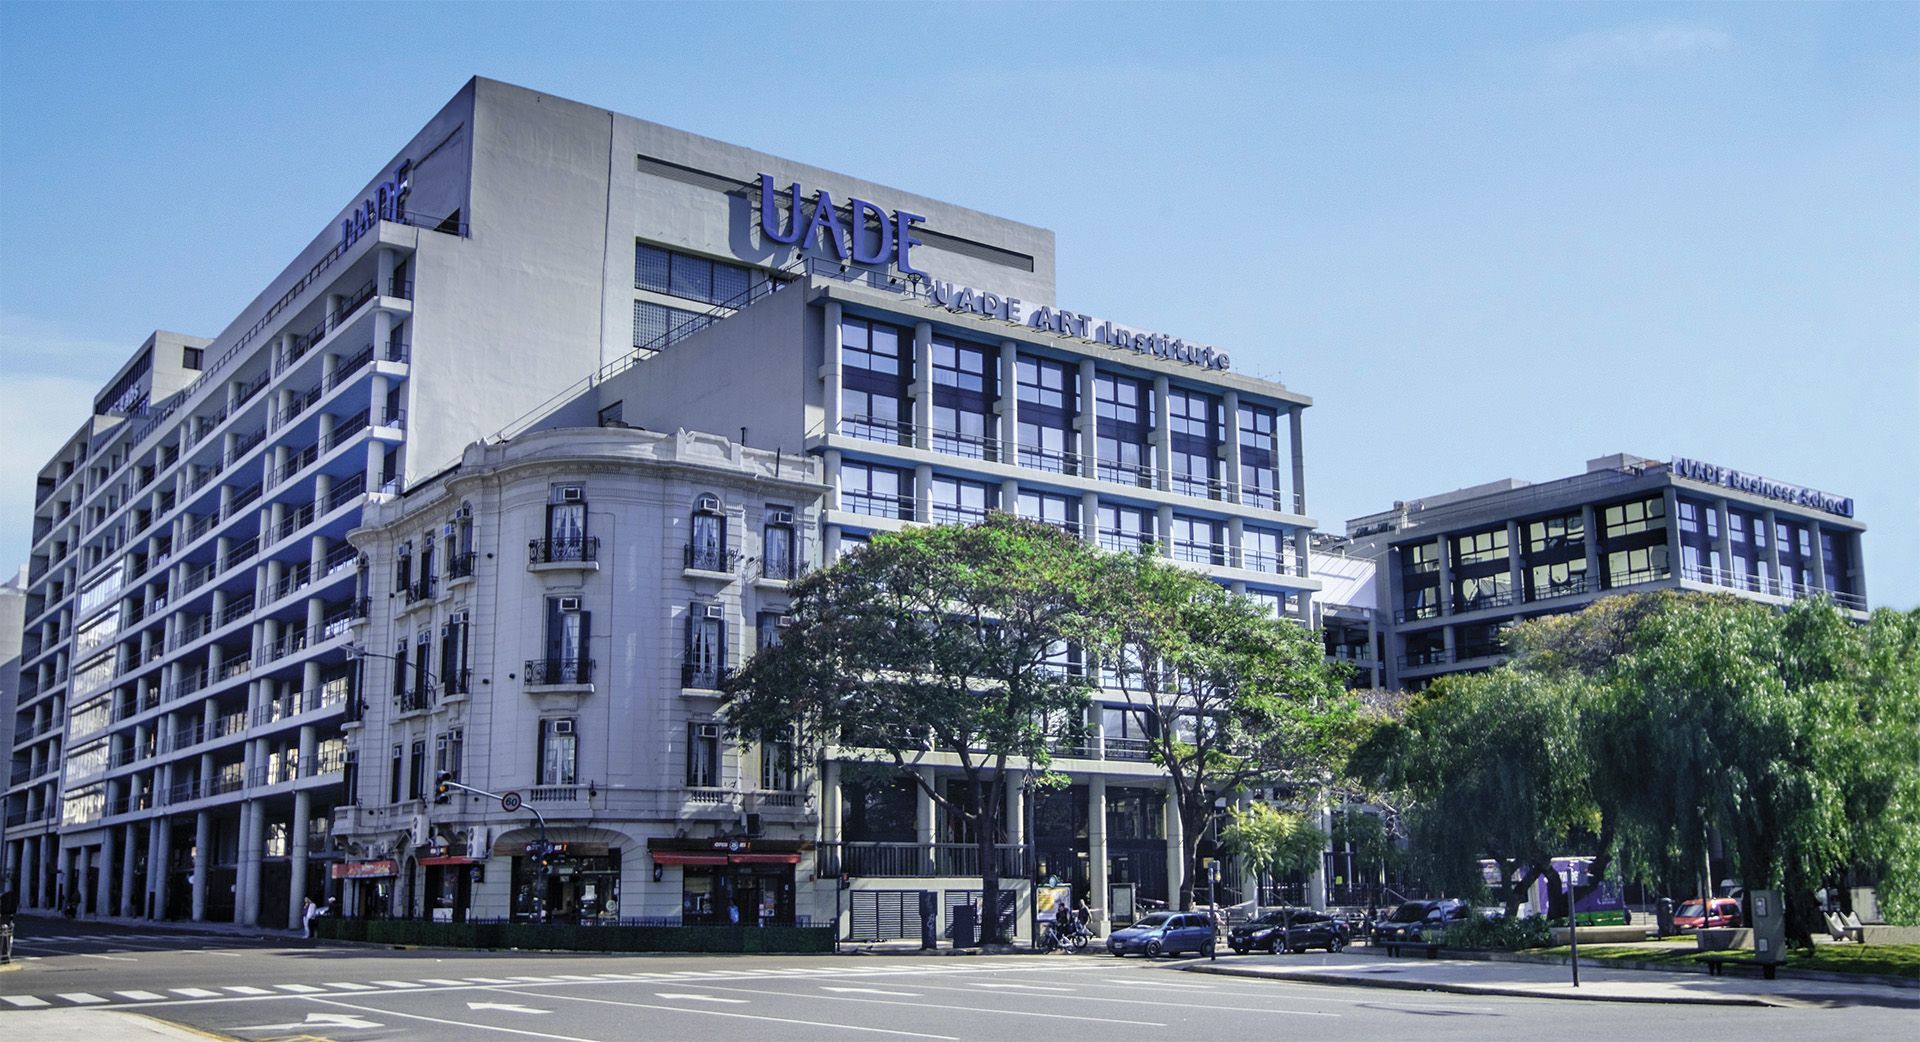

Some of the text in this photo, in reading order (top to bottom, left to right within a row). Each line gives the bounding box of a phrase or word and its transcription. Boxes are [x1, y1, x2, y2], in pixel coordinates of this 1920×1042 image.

[757, 172, 926, 275] UADE
[933, 280, 1230, 370] UADE ART Institute
[1681, 458, 1854, 518] UADE Business School
[505, 797, 518, 807] 60
